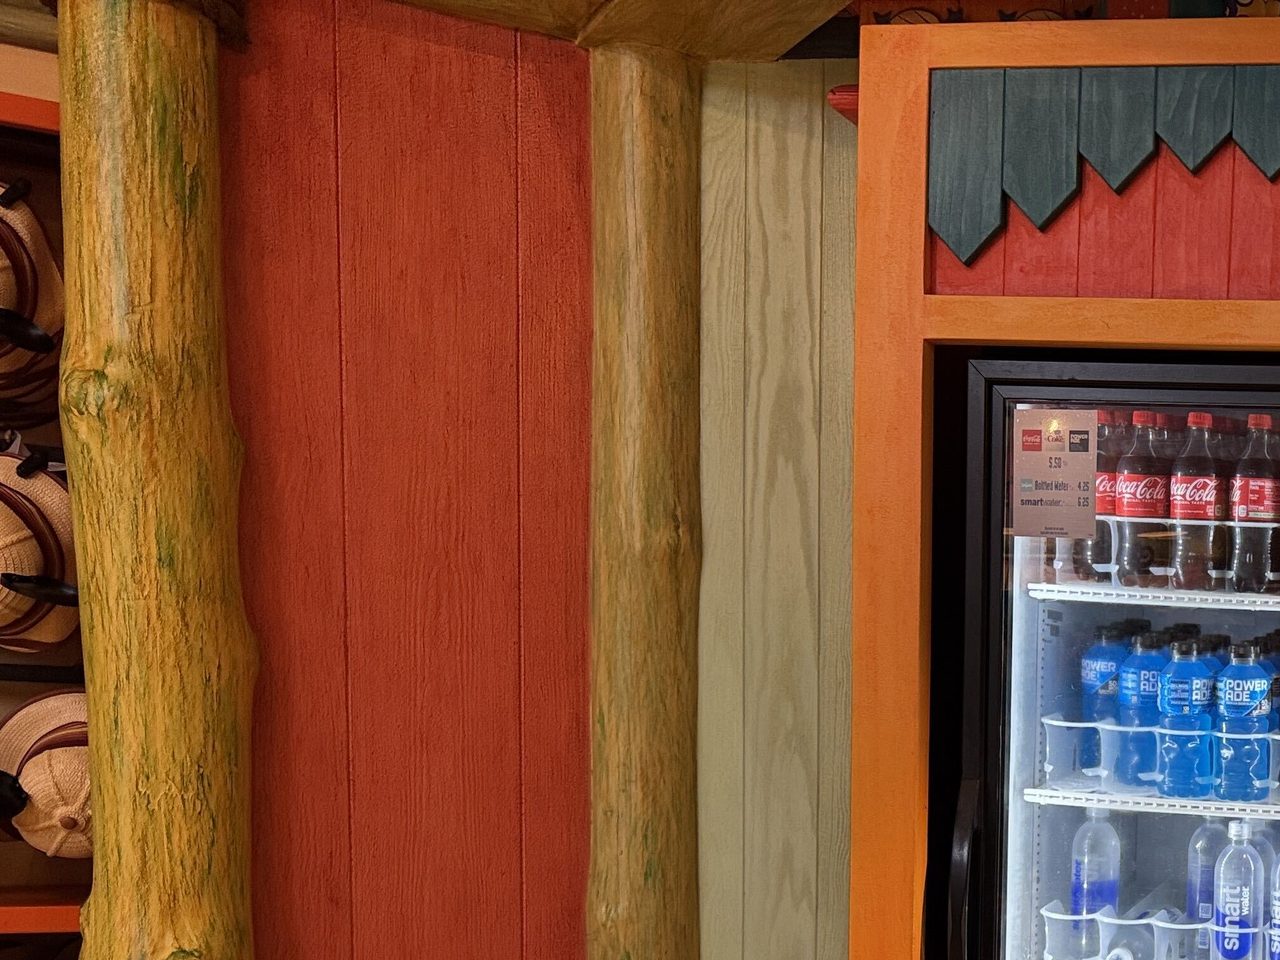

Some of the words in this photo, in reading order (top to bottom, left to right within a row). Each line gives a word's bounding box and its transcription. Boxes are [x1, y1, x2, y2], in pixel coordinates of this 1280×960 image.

[1226, 680, 1268, 690] POWER
[1226, 691, 1251, 701] ADE
[1241, 886, 1250, 915] water
[1224, 885, 1241, 951] smart
